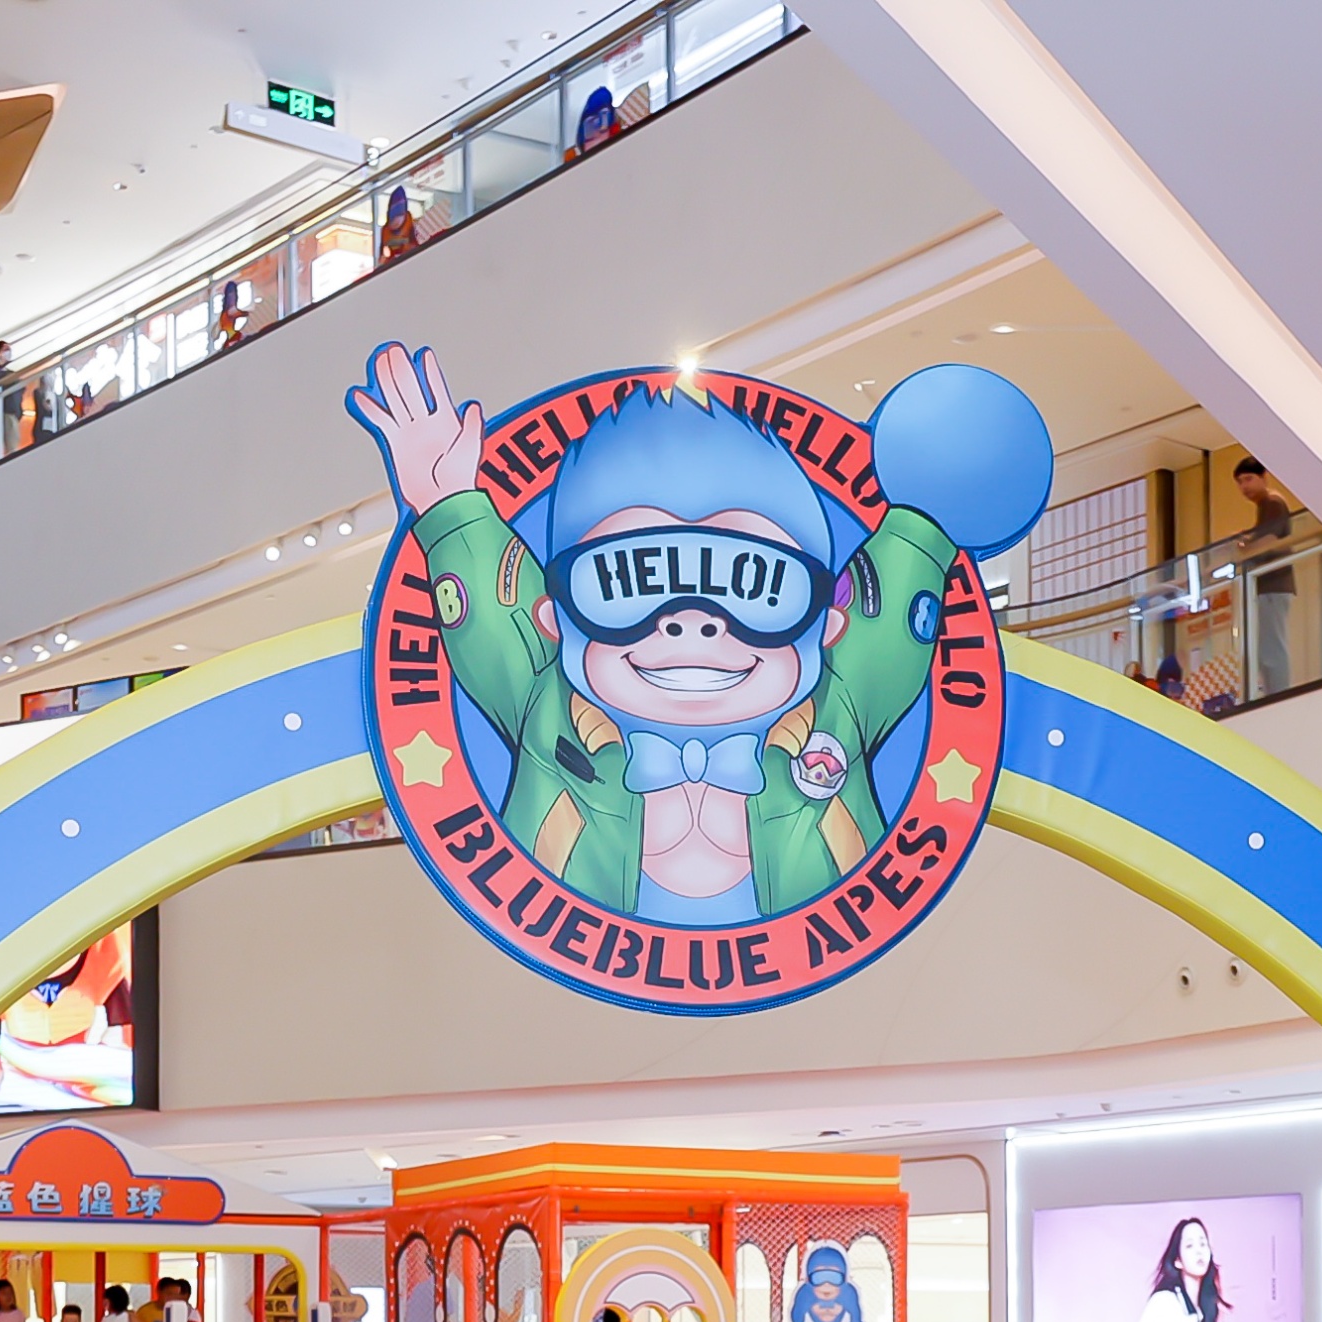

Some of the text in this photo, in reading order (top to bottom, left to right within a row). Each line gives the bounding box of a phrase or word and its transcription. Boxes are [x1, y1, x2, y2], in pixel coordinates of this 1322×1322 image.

[479, 379, 649, 499] HEL
[592, 546, 787, 607] HELLO!
[936, 562, 987, 709] ELLO
[433, 804, 948, 990] BLUEBLUE APES
